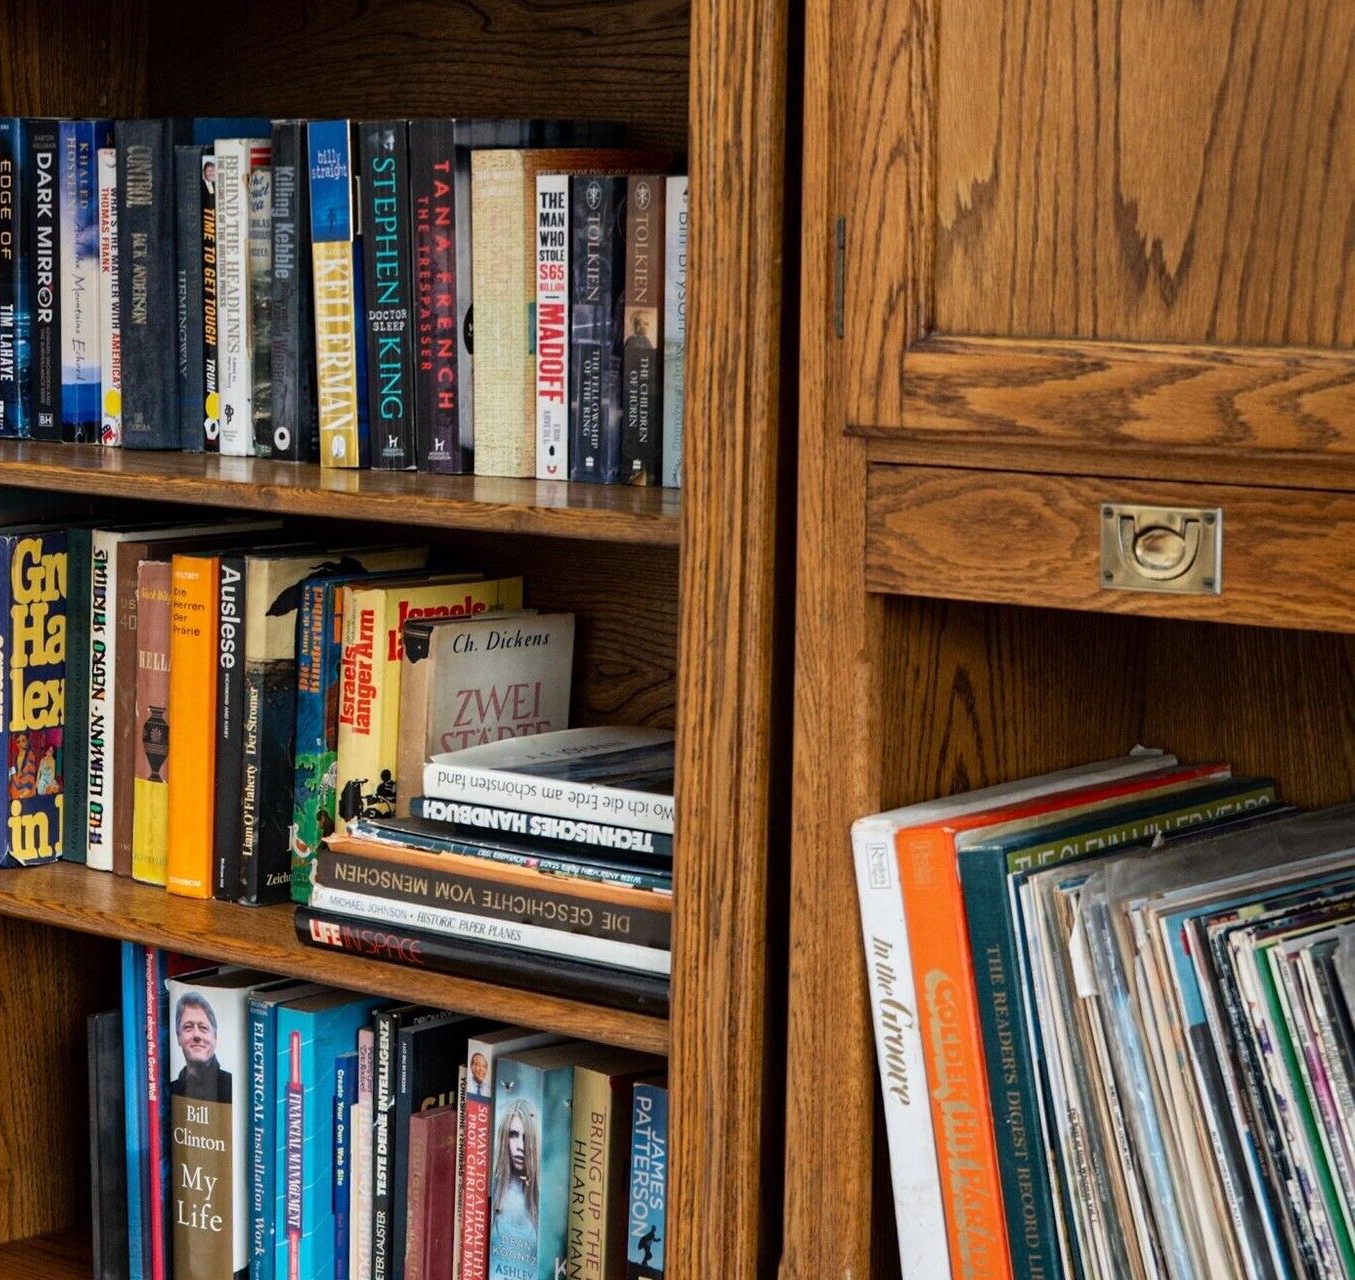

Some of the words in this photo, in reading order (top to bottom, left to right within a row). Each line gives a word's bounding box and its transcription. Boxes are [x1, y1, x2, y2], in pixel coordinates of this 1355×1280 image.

[79, 142, 89, 210] KHALED
[126, 145, 153, 209] CONTROL
[311, 165, 348, 181] straight
[318, 148, 341, 166] billy
[0, 159, 12, 220] EDGE
[36, 152, 53, 218] DARK
[225, 155, 239, 217] BEHIND
[271, 166, 294, 218] Killing
[539, 192, 565, 209] THE
[101, 187, 110, 234] THOMAS
[110, 187, 119, 228] WHAT'S
[204, 208, 216, 245] TIME
[416, 196, 430, 232] THE
[434, 160, 451, 253] TANA
[539, 213, 565, 228] MAN
[0, 231, 12, 261] OF
[111, 231, 119, 252] THE
[226, 224, 239, 255] THE
[372, 157, 399, 304] STEPHEN
[539, 230, 565, 248] WHO
[101, 237, 110, 273] FRANK
[204, 246, 216, 264] TO
[275, 223, 294, 279] Kebble
[539, 249, 565, 261] STOLE
[587, 213, 601, 301] TOLKIEN
[634, 213, 649, 303] TOLKIEN
[37, 226, 53, 323] MIRROR
[111, 255, 120, 300] MATTER
[131, 263, 148, 325] ANDERSON
[204, 268, 216, 296] GET
[0, 304, 14, 328] TIM
[72, 273, 86, 335] Mountains
[111, 304, 120, 329] WITH
[204, 299, 217, 347] TOUGH
[226, 261, 240, 354] HEADLINES
[369, 308, 407, 321] DOCTOR
[418, 247, 433, 370] TRESPASSER
[316, 258, 354, 432] KELLERMAN
[372, 321, 405, 332] SLEEP
[436, 274, 454, 409] FRENCH
[111, 333, 121, 390] AMERICA?
[538, 303, 565, 404] MADOFF
[640, 358, 649, 380] THE
[378, 336, 404, 420] KING
[583, 407, 592, 436] RING
[591, 375, 599, 449] FELLOWSHIP
[639, 383, 650, 443] CHILDREN
[173, 587, 187, 596] Die
[173, 601, 205, 611] Herren
[173, 613, 189, 622] der
[220, 564, 241, 669] Auslese
[355, 609, 375, 659] Arm
[310, 586, 324, 692] Kinderbibel
[453, 633, 478, 654] Ch.
[487, 629, 551, 651] Dickens
[91, 641, 106, 700] NEGRO
[339, 646, 357, 725] Israels
[246, 687, 258, 732] Stromer
[352, 658, 376, 735] langer
[453, 681, 542, 727] ZWEI
[90, 715, 105, 796] LEHMANN
[246, 733, 256, 754] Der
[243, 763, 258, 825] O'Flaherty
[437, 770, 466, 790] fand
[470, 776, 538, 799] schönsten
[541, 786, 563, 801] am
[422, 799, 527, 834] HANDBUCH
[568, 791, 599, 810] Erde
[602, 795, 624, 814] die
[628, 799, 649, 818] ich
[88, 802, 103, 849] THEO
[242, 827, 254, 856] Liam
[528, 814, 654, 854] TECHNISCHES
[334, 862, 428, 896] MENSCHEN
[435, 881, 475, 905] VOM
[330, 896, 364, 913] MICHAEL
[368, 903, 407, 920] JOHNSON
[416, 911, 456, 929] HISTORIC
[458, 919, 485, 935] PAPER
[488, 924, 522, 941] PLANES
[481, 890, 593, 926] GESCHICHTE
[602, 911, 630, 933] DIE
[310, 919, 343, 947] LIFE
[872, 937, 894, 960] In
[876, 963, 897, 996] the
[985, 943, 1004, 983] THE
[880, 998, 913, 1107] Groove
[992, 990, 1019, 1084] READER'S
[148, 1057, 157, 1081] Great
[253, 1021, 265, 1122] ELECTRICAL
[336, 1069, 345, 1098] Create
[377, 1021, 390, 1113] INTELLIGENZ
[186, 1105, 210, 1126] Bill
[288, 1092, 302, 1148] FINANCIAL
[336, 1101, 345, 1121] Your
[1005, 1090, 1028, 1159] DIGEST
[173, 1127, 226, 1152] Clinton
[336, 1124, 345, 1144] Own
[377, 1114, 389, 1155] DEINE
[467, 1113, 476, 1150] PROF.
[476, 1126, 487, 1166] WAYS
[588, 1111, 604, 1183] BRING
[253, 1126, 265, 1211] Installation
[336, 1147, 345, 1166] Web
[377, 1156, 389, 1196] TESTE
[631, 1095, 652, 1238] PATTERSON
[650, 1130, 665, 1211] JAMES
[181, 1165, 218, 1199] My
[287, 1149, 302, 1228] MANAGEMENT
[336, 1169, 345, 1186] Site
[475, 1172, 486, 1191] TO
[572, 1139, 586, 1222] HILARY
[176, 1200, 223, 1232] Life
[464, 1154, 476, 1245] CHRISTIAAN
[474, 1194, 485, 1205] A
[587, 1189, 600, 1221] UP
[1017, 1167, 1040, 1248] RECORD
[253, 1216, 265, 1256] Work
[375, 1210, 386, 1254] LAUSTER
[473, 1209, 485, 1279] HEALTHY
[501, 1234, 531, 1251] DEAN
[585, 1227, 600, 1271] THE
[492, 1245, 537, 1265] KOONTZ
